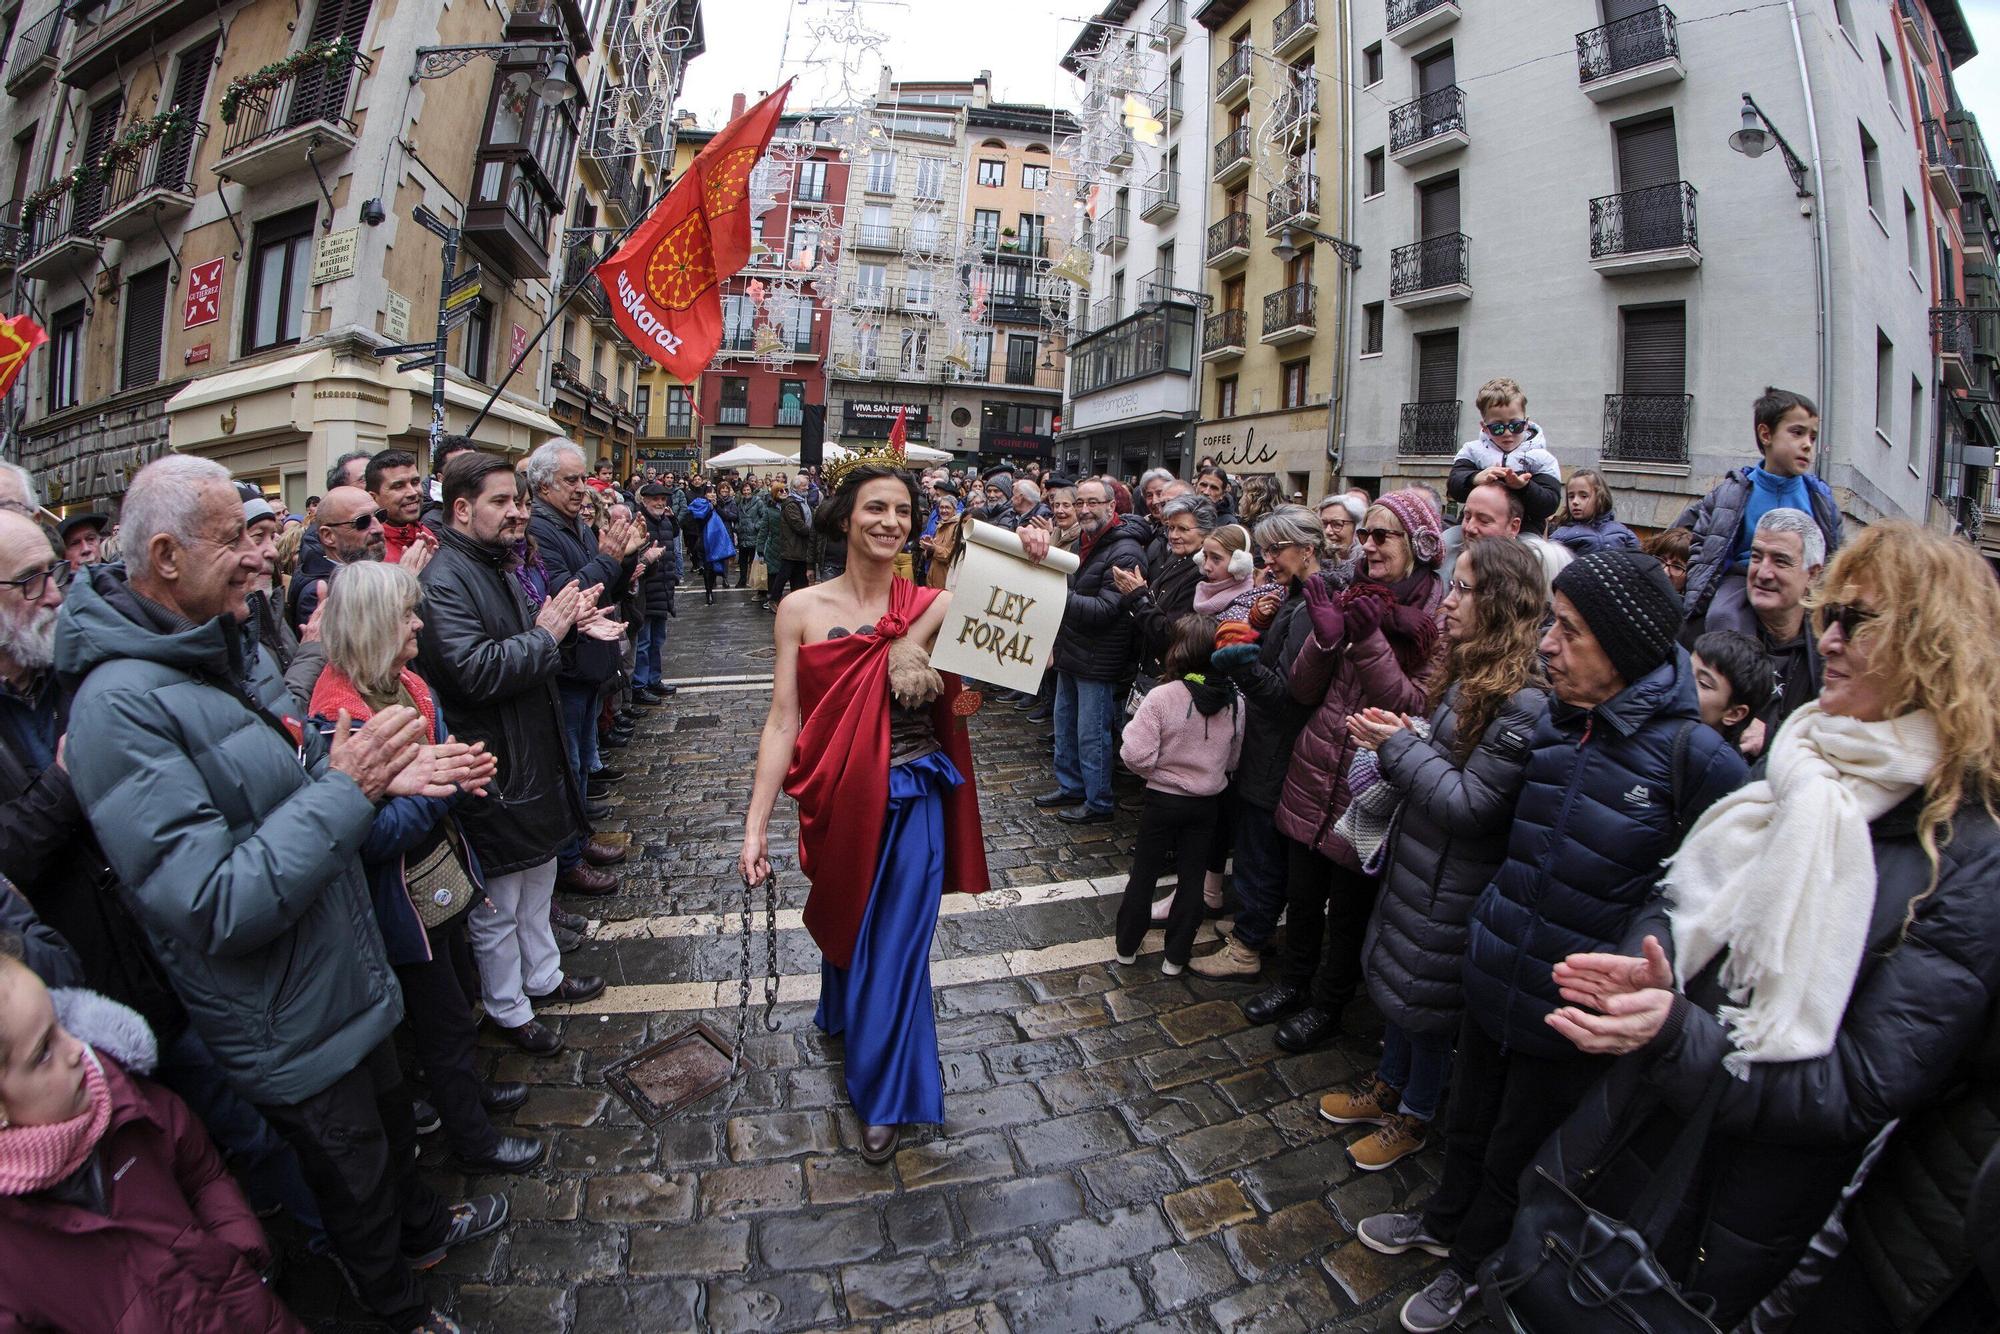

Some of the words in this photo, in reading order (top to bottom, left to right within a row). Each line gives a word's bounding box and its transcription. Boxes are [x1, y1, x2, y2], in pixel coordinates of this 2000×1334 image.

[331, 238, 343, 246] CALLE
[322, 244, 350, 257] MERCADERES
[320, 256, 349, 268] MERCADERES
[188, 285, 219, 301] GUTIERREZ
[618, 269, 684, 355] euskaraz
[873, 404, 890, 412] SAN
[1203, 434, 1231, 446] COFFEE
[984, 585, 1036, 625] LEY
[956, 615, 1035, 666] FORAL
